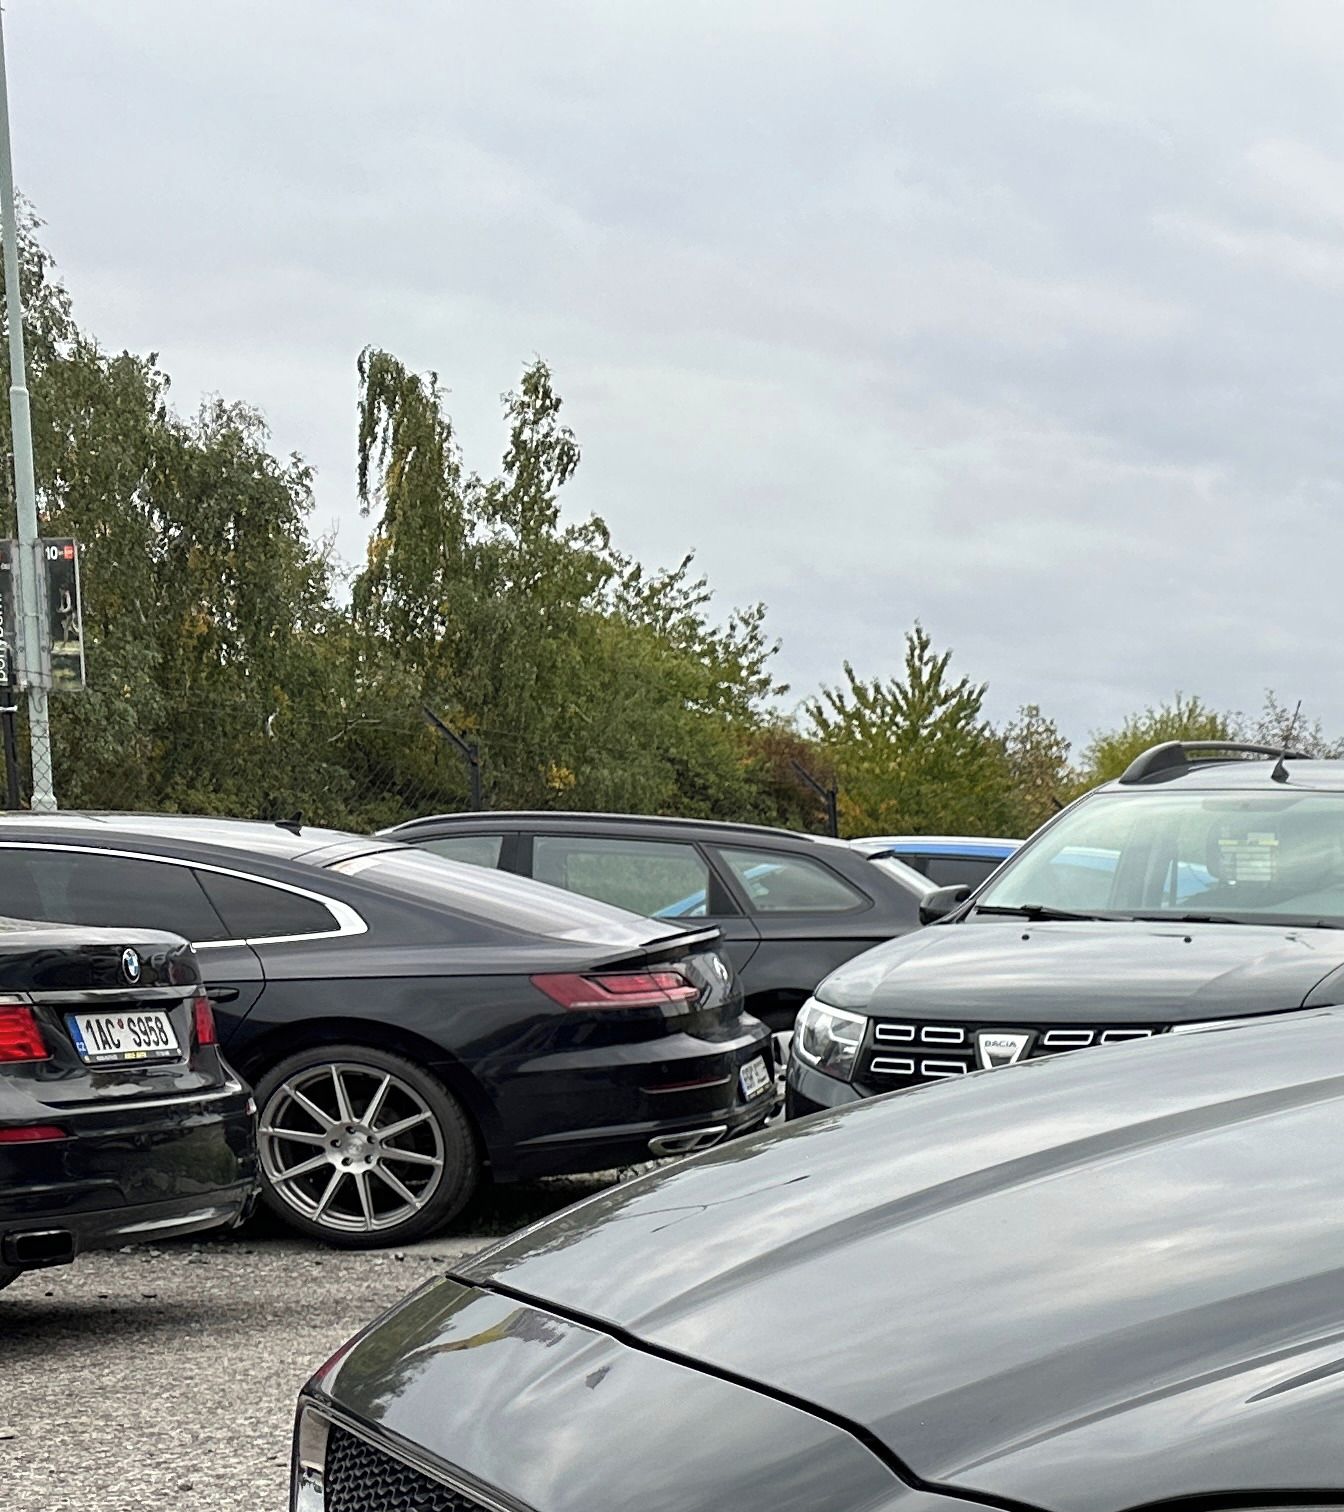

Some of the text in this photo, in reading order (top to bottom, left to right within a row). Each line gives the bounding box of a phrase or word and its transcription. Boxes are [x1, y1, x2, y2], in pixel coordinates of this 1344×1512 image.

[46, 546, 57, 560] 10
[85, 1016, 169, 1051] 1AC S958
